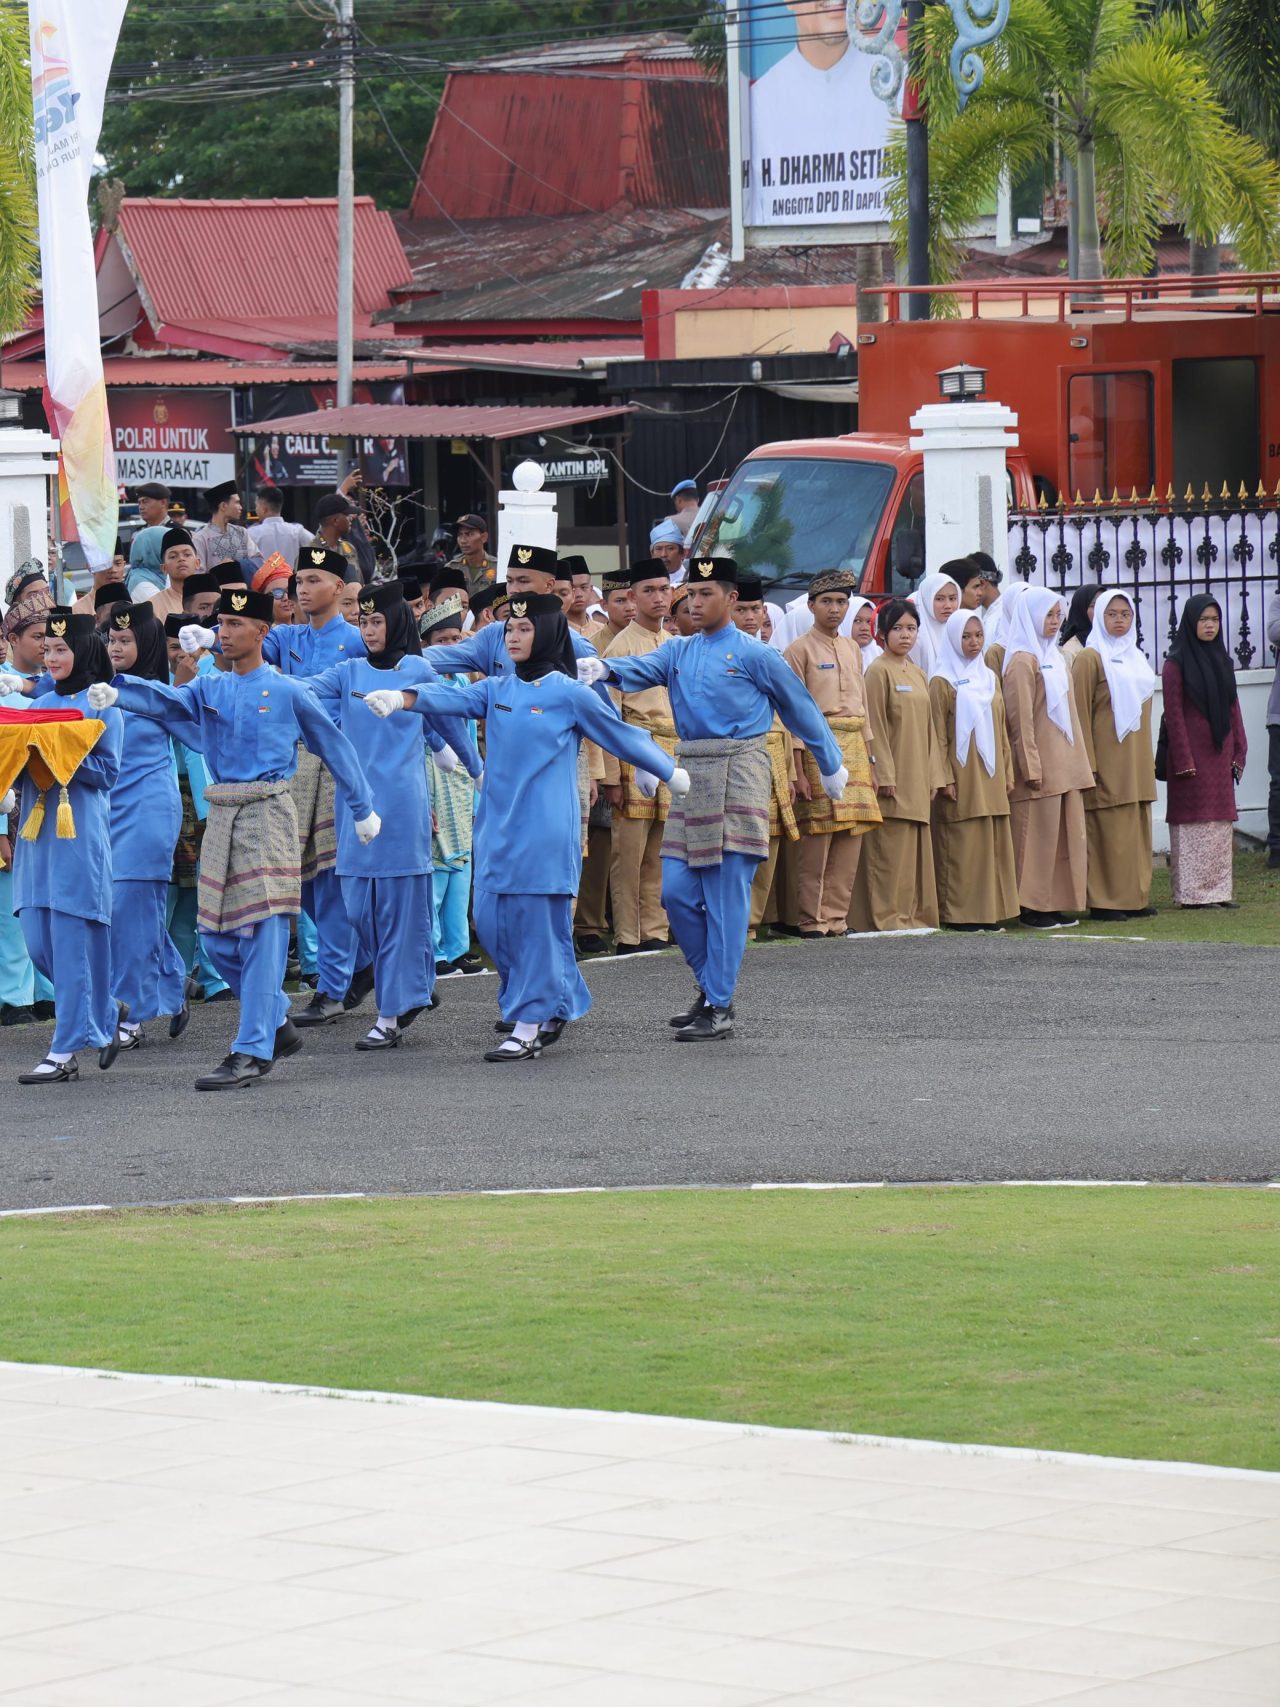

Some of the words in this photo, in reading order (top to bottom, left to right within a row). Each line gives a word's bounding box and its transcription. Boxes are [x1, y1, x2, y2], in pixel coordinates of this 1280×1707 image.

[762, 158, 775, 187] H.
[780, 152, 846, 186] DHARMA
[772, 197, 814, 216] ANGGOTA
[816, 191, 840, 213] DPD
[842, 189, 854, 212] RI
[856, 191, 882, 210] DAPIL
[115, 427, 157, 450] POLRI
[160, 428, 209, 450] UNTUK
[285, 436, 320, 454] CALL
[118, 458, 210, 481] MASYARAKAT
[542, 461, 585, 476] KANTIN
[586, 459, 608, 474] RPL
